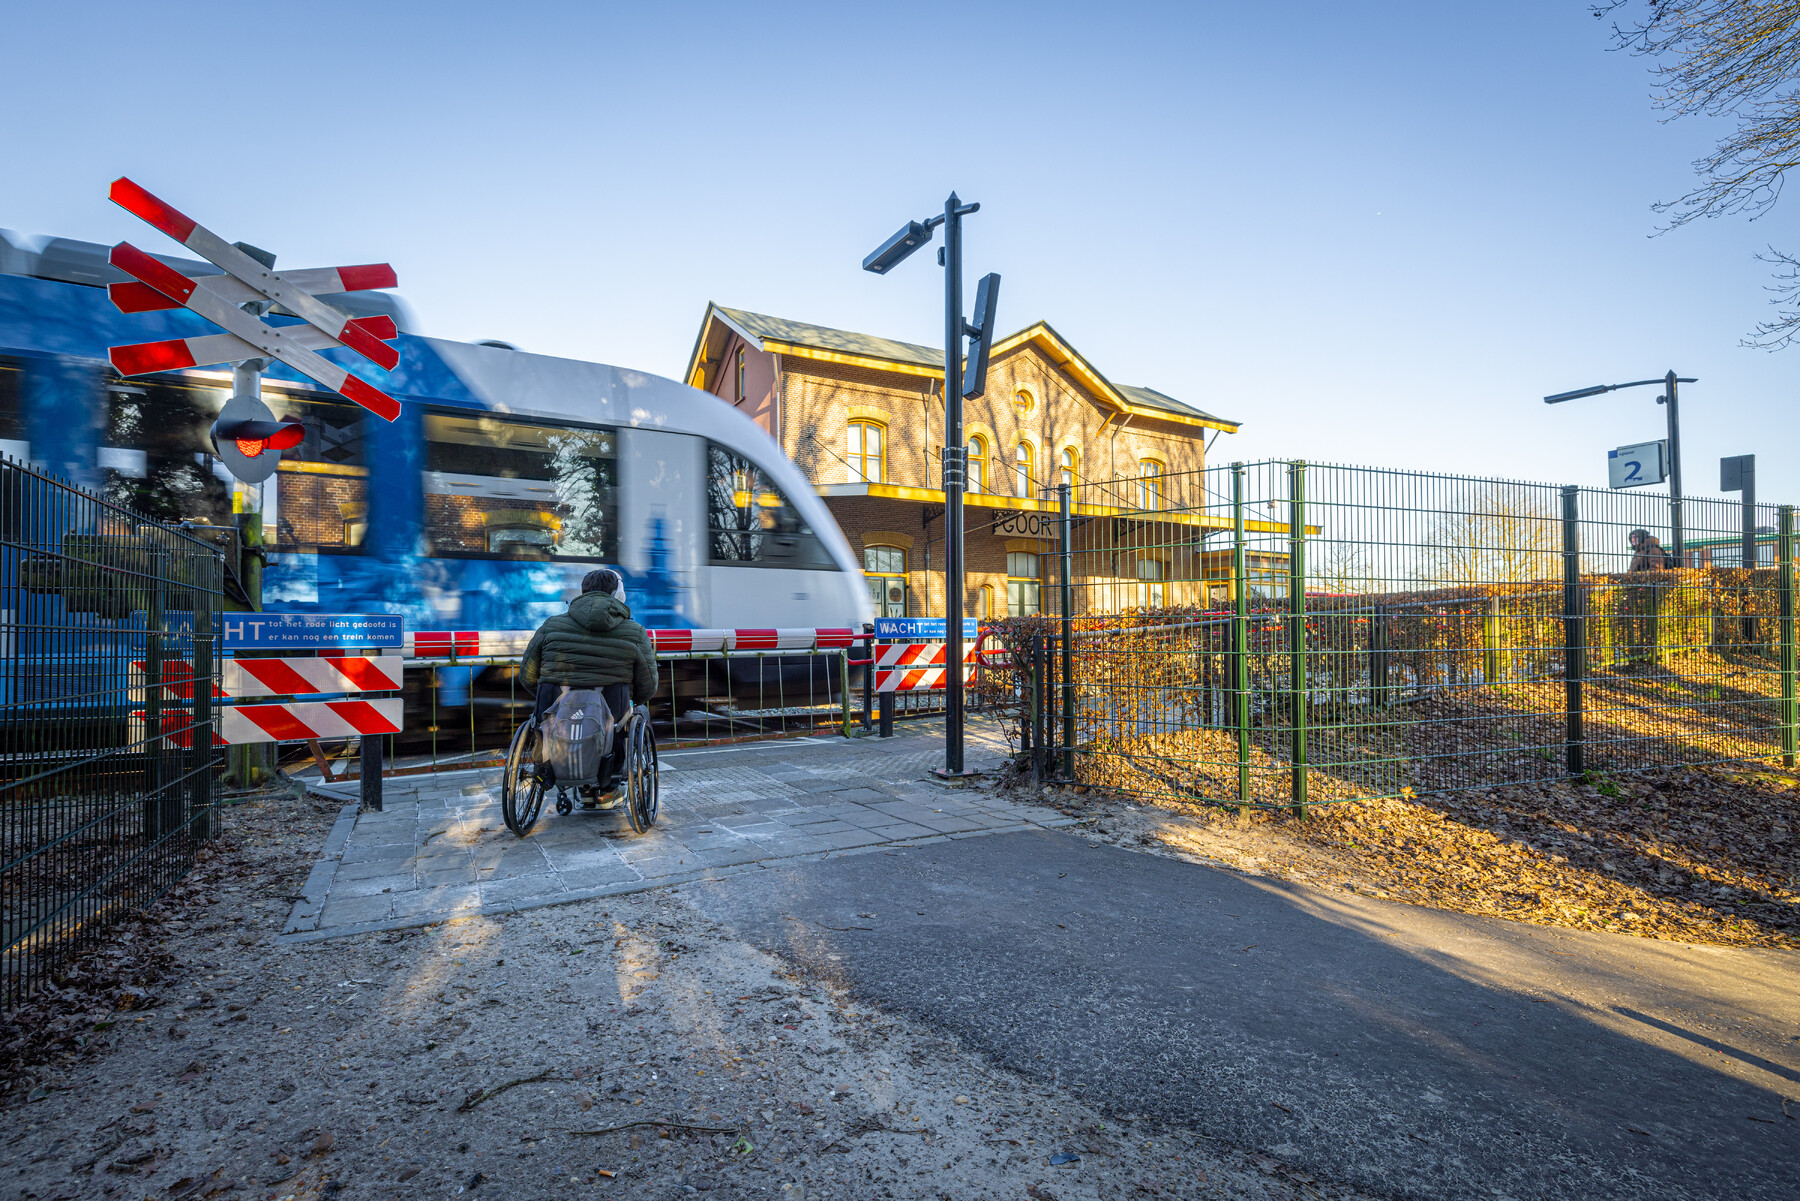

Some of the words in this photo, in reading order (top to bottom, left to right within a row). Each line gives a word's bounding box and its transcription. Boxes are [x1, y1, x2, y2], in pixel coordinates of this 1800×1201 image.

[1624, 461, 1643, 482] 2
[1002, 514, 1052, 536] GOOR
[352, 621, 386, 630] gedoofd
[879, 622, 923, 634] WACHT
[302, 634, 320, 642] nog
